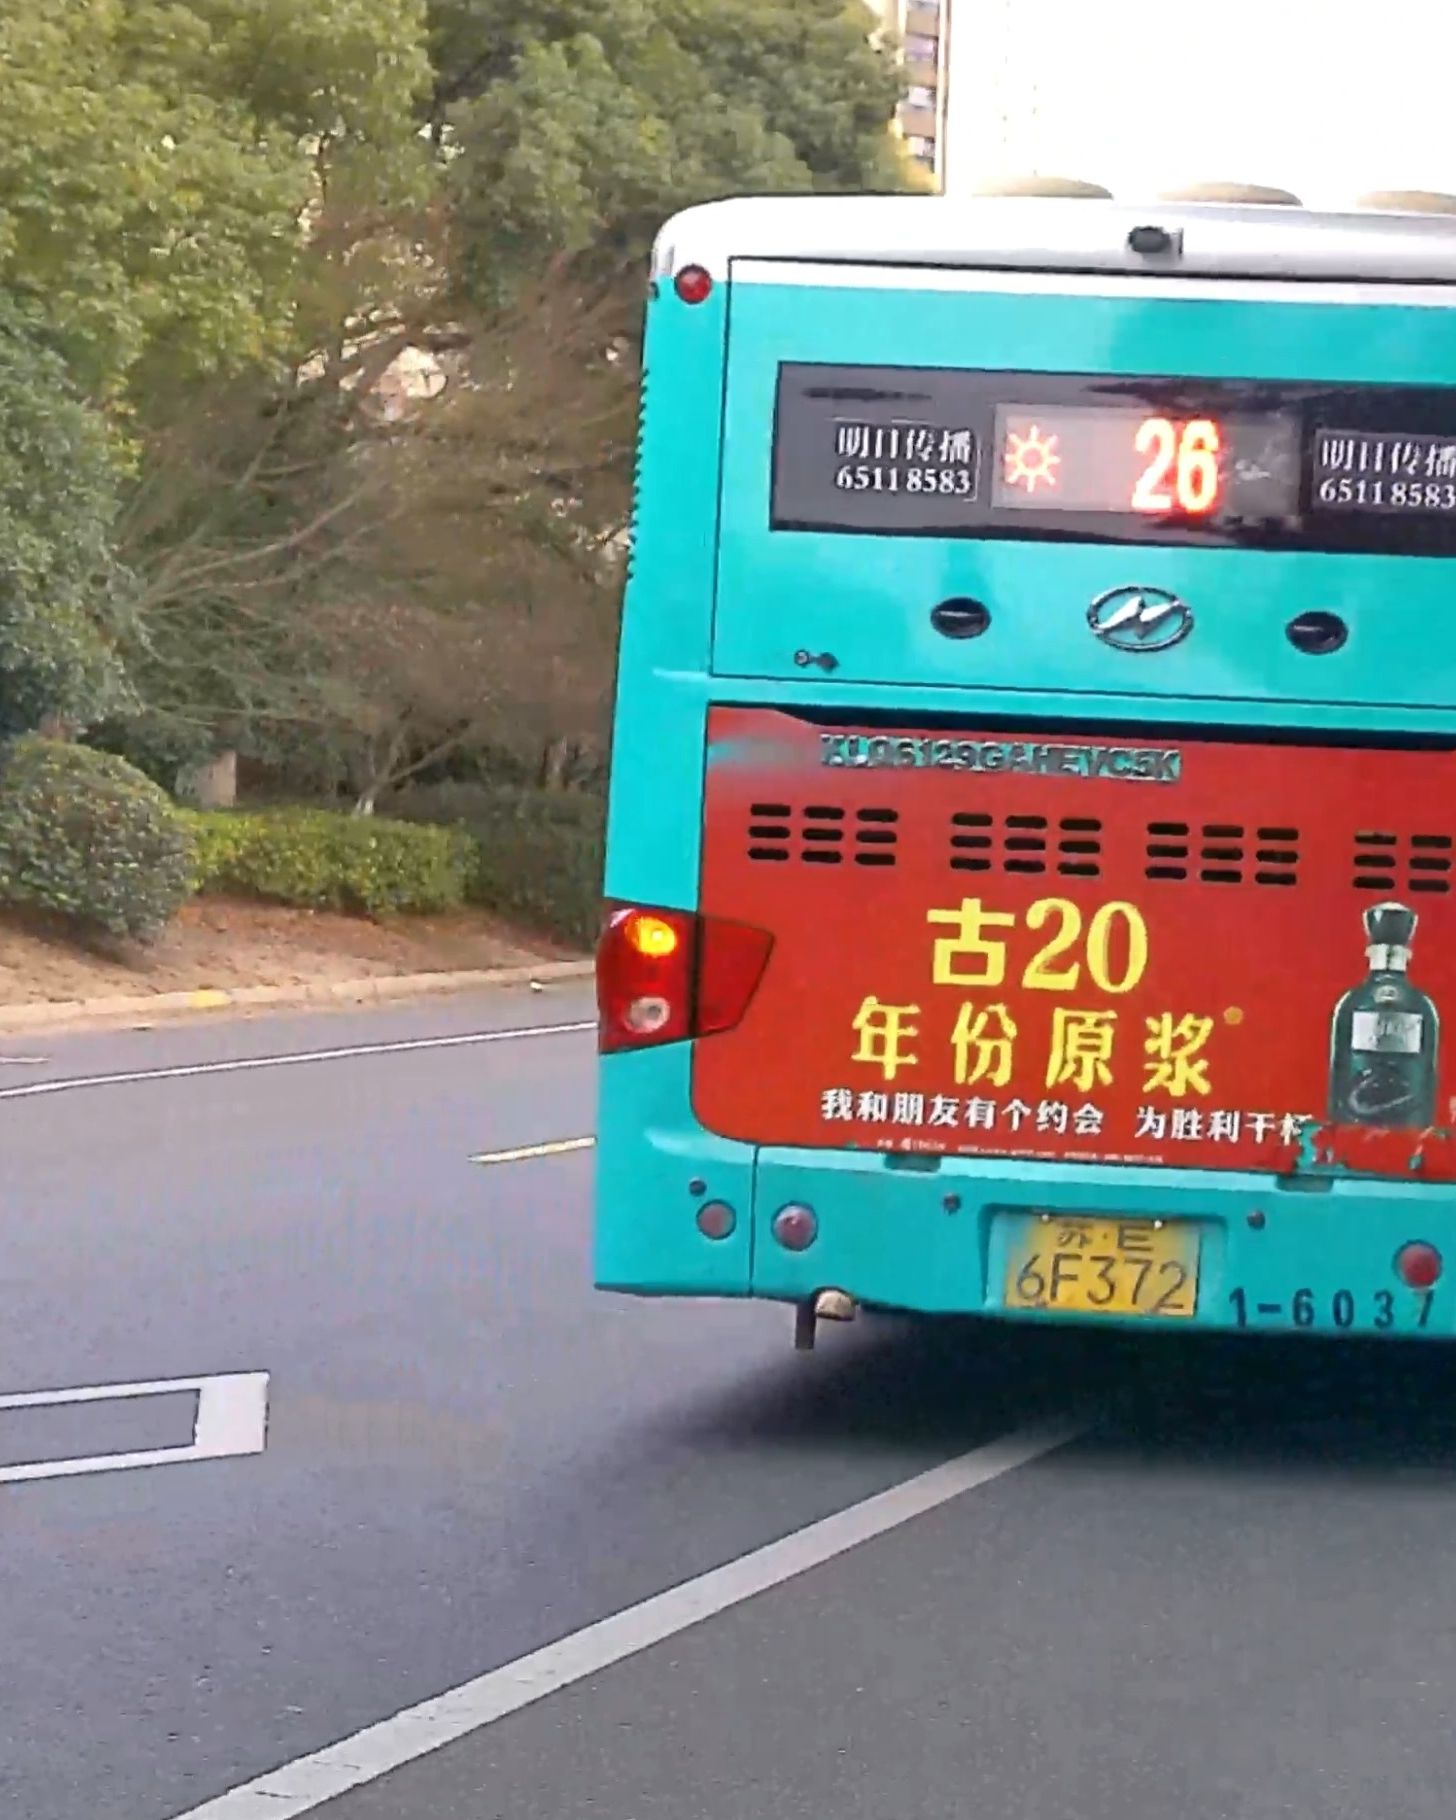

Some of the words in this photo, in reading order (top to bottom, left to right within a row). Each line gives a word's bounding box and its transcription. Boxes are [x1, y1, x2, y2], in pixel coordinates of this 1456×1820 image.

[836, 465, 971, 494] 65118583
[1131, 418, 1219, 513] 26
[1319, 478, 1456, 509] 65118583
[926, 897, 1149, 994] 古20
[851, 995, 1215, 1097] 年份原浆
[821, 1087, 1104, 1136] 我和朋友有个约会
[1016, 1253, 1187, 1314] 6F372
[1229, 1286, 1435, 1329] 1-6037
